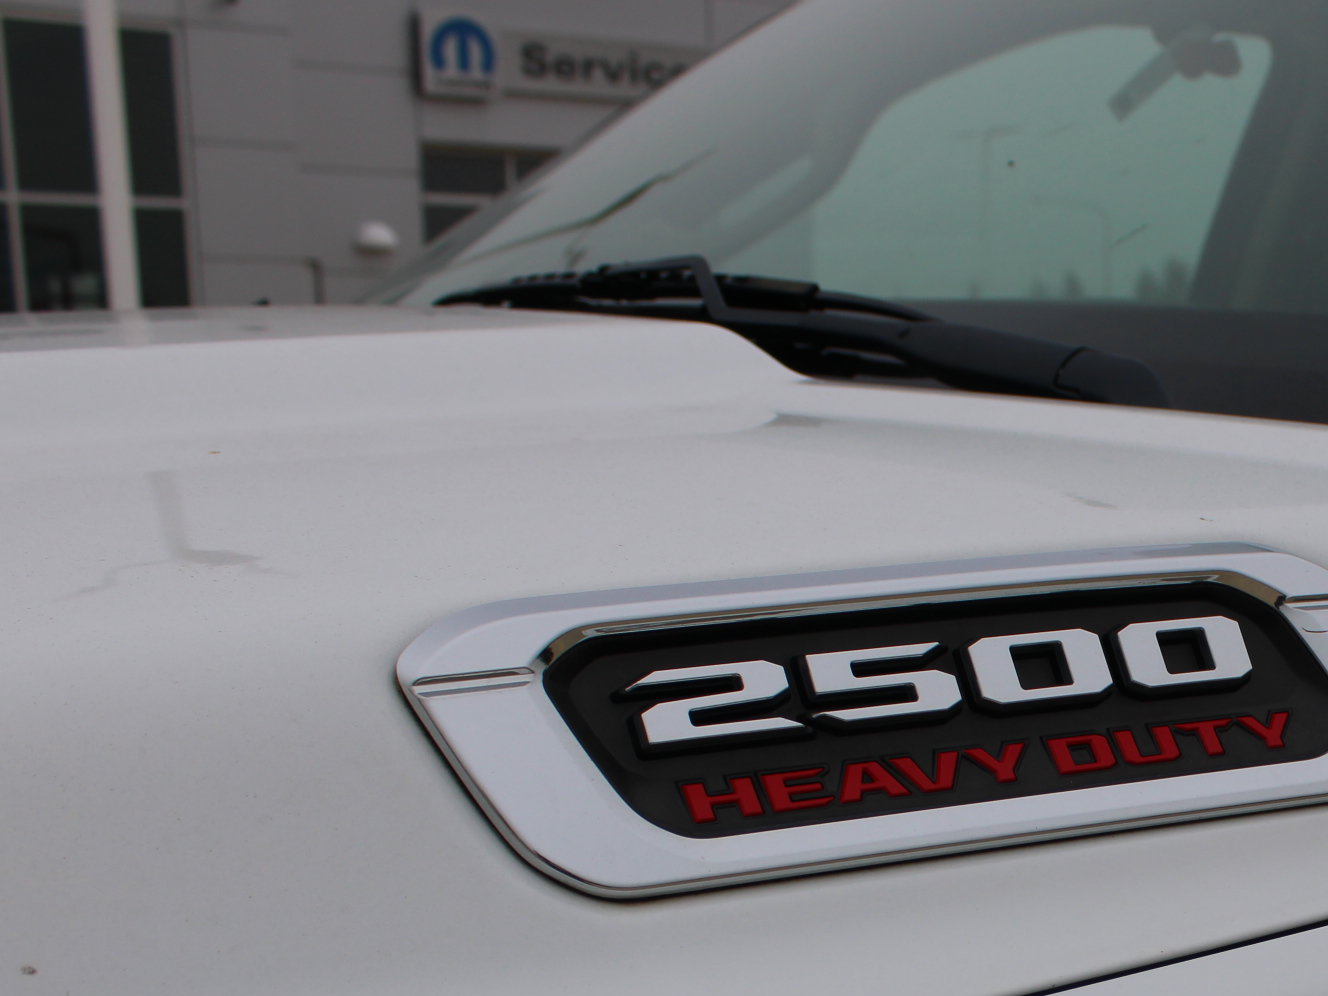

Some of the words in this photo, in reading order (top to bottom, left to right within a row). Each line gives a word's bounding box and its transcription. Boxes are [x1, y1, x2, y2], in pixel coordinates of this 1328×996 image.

[622, 615, 1253, 746] 2500
[678, 741, 1027, 824] HEAVY
[1044, 712, 1291, 776] DUTY
